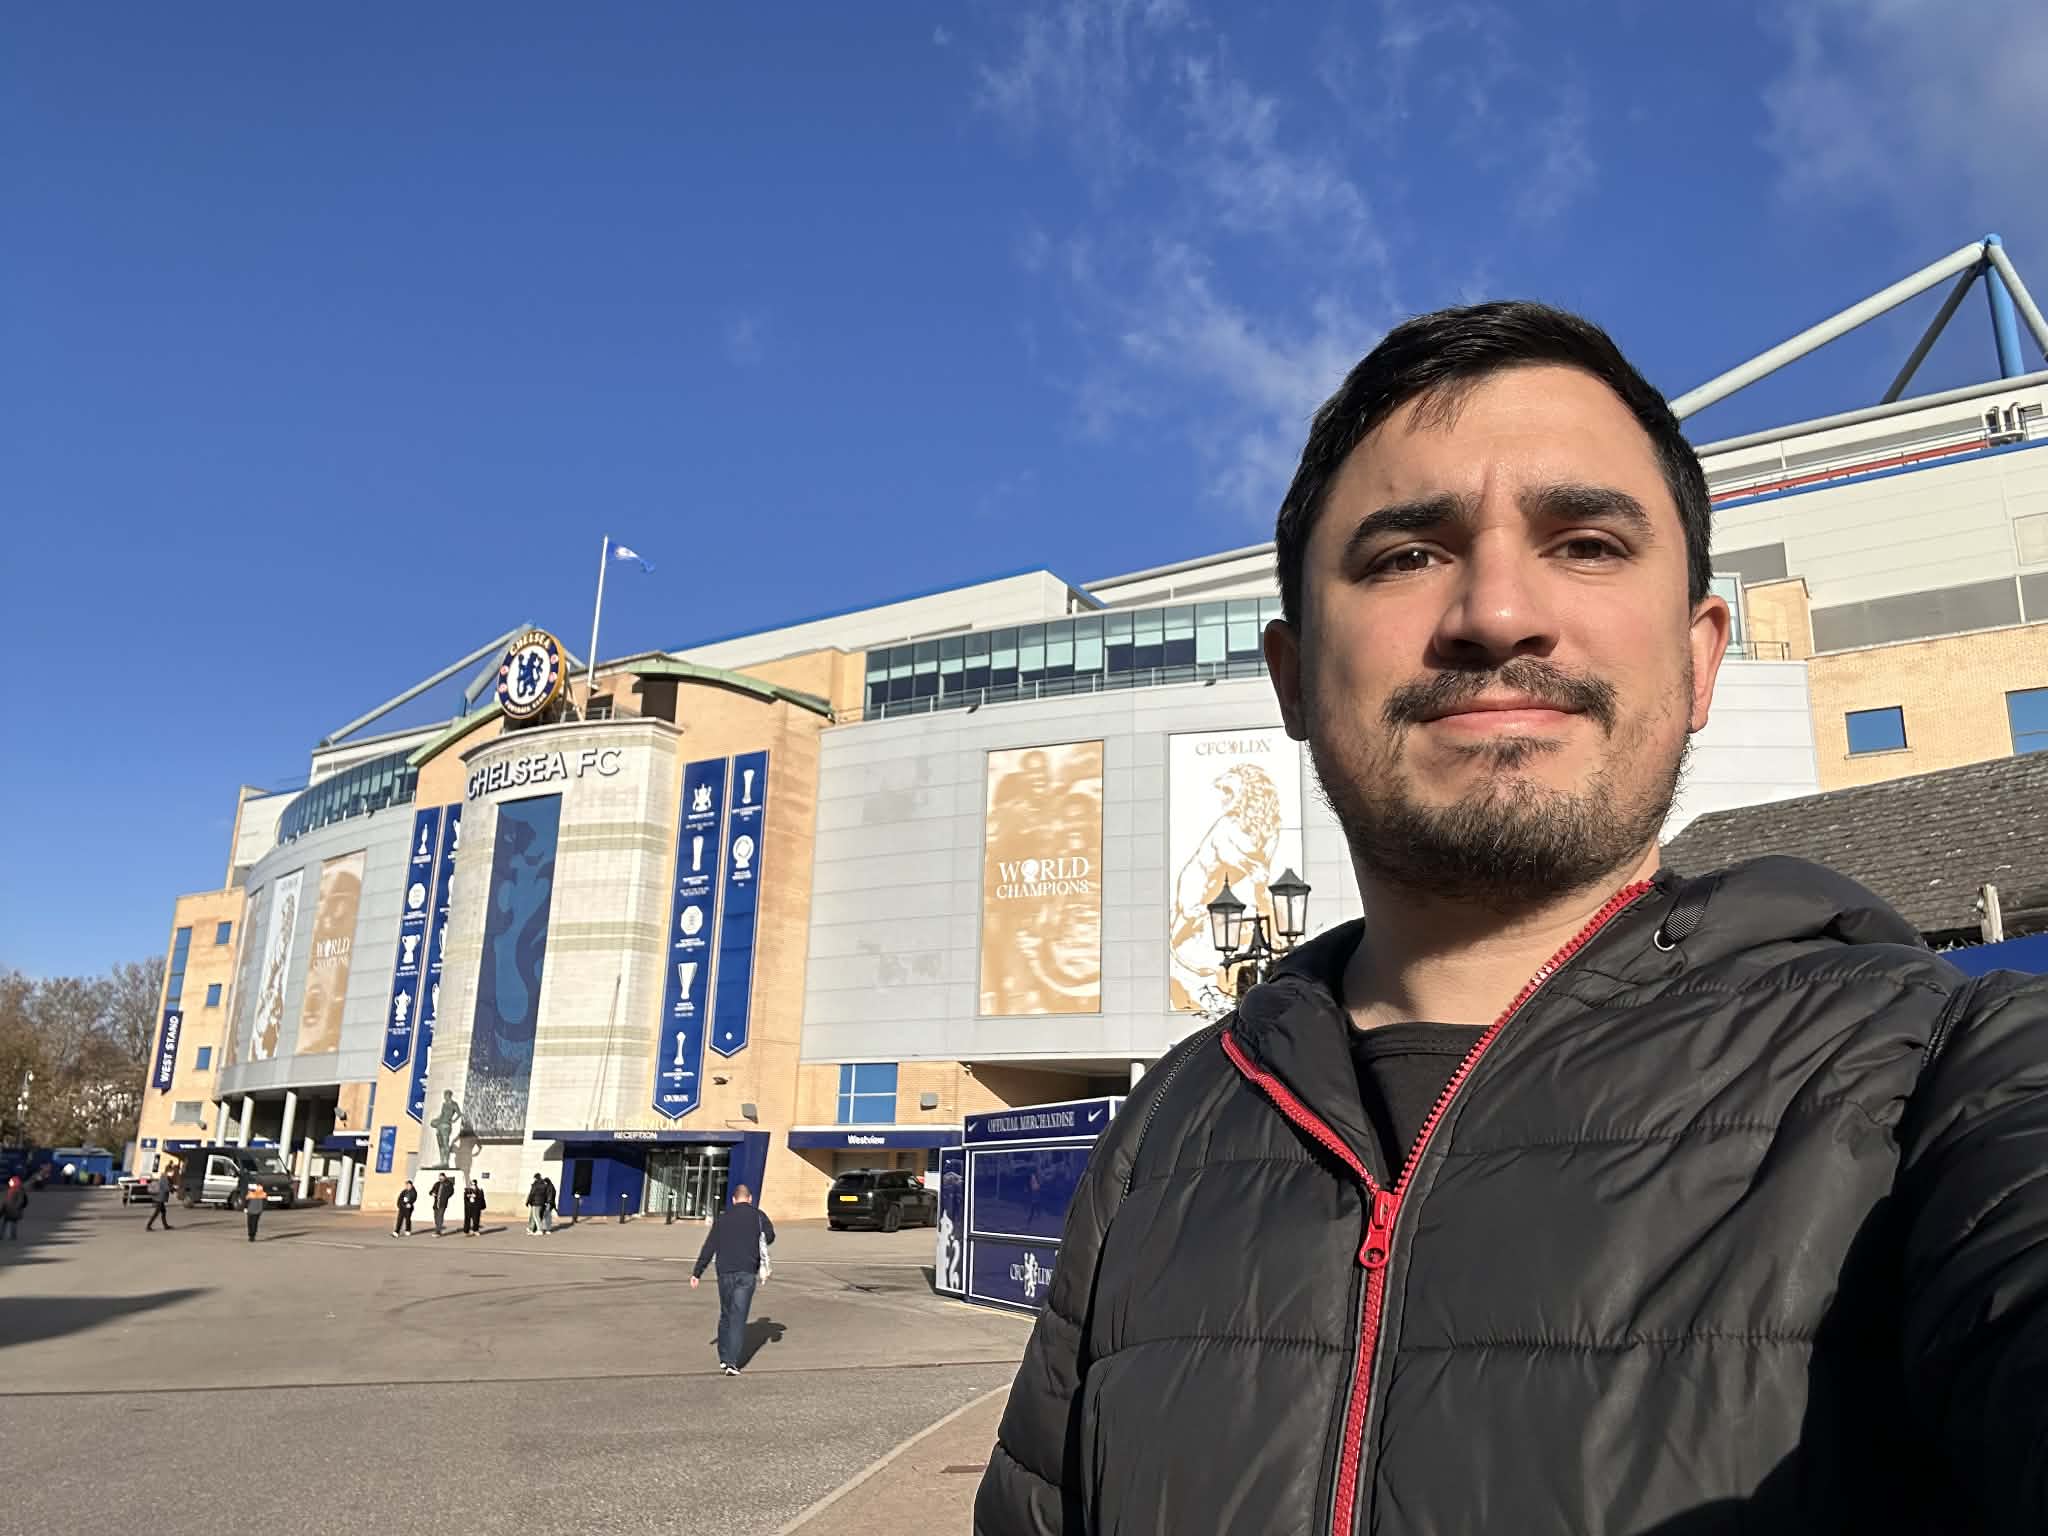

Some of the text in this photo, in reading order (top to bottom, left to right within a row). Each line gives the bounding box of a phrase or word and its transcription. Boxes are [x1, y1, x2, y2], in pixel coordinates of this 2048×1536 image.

[509, 632, 551, 655] CHELSEA
[467, 748, 622, 801] CHELSEA FC
[999, 856, 1089, 883] WORLD
[996, 880, 1089, 899] CHAMPIONS
[160, 1015, 179, 1082] WEST STAND
[1020, 1111, 1075, 1130] MERCHANDISE
[613, 1131, 658, 1140] RECEPTION
[847, 1133, 886, 1145] Westview
